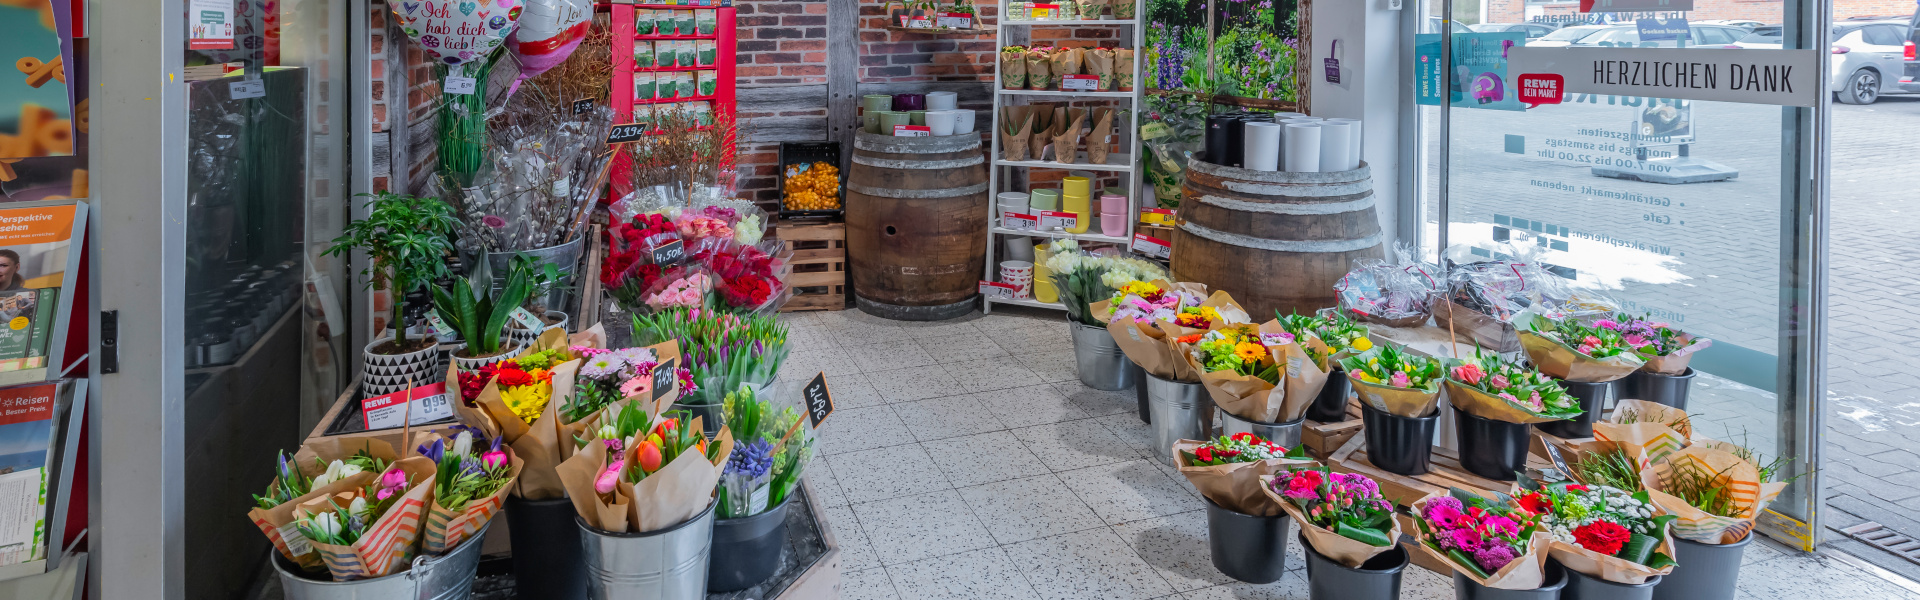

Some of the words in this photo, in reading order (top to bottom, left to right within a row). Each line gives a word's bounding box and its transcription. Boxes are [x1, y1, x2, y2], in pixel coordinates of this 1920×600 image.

[421, 1, 451, 18] Ich
[565, 2, 583, 24] Love
[426, 19, 450, 35] hab
[457, 20, 487, 36] dich
[444, 37, 474, 50] lieb!
[1593, 60, 1717, 89] HERZLICHEN
[1730, 62, 1794, 93] DANK
[1524, 79, 1556, 88] REWE
[1524, 88, 1536, 97] DEIN
[1539, 89, 1556, 98] MARKT
[16, 396, 49, 406] Reisen
[365, 397, 392, 409] REWE
